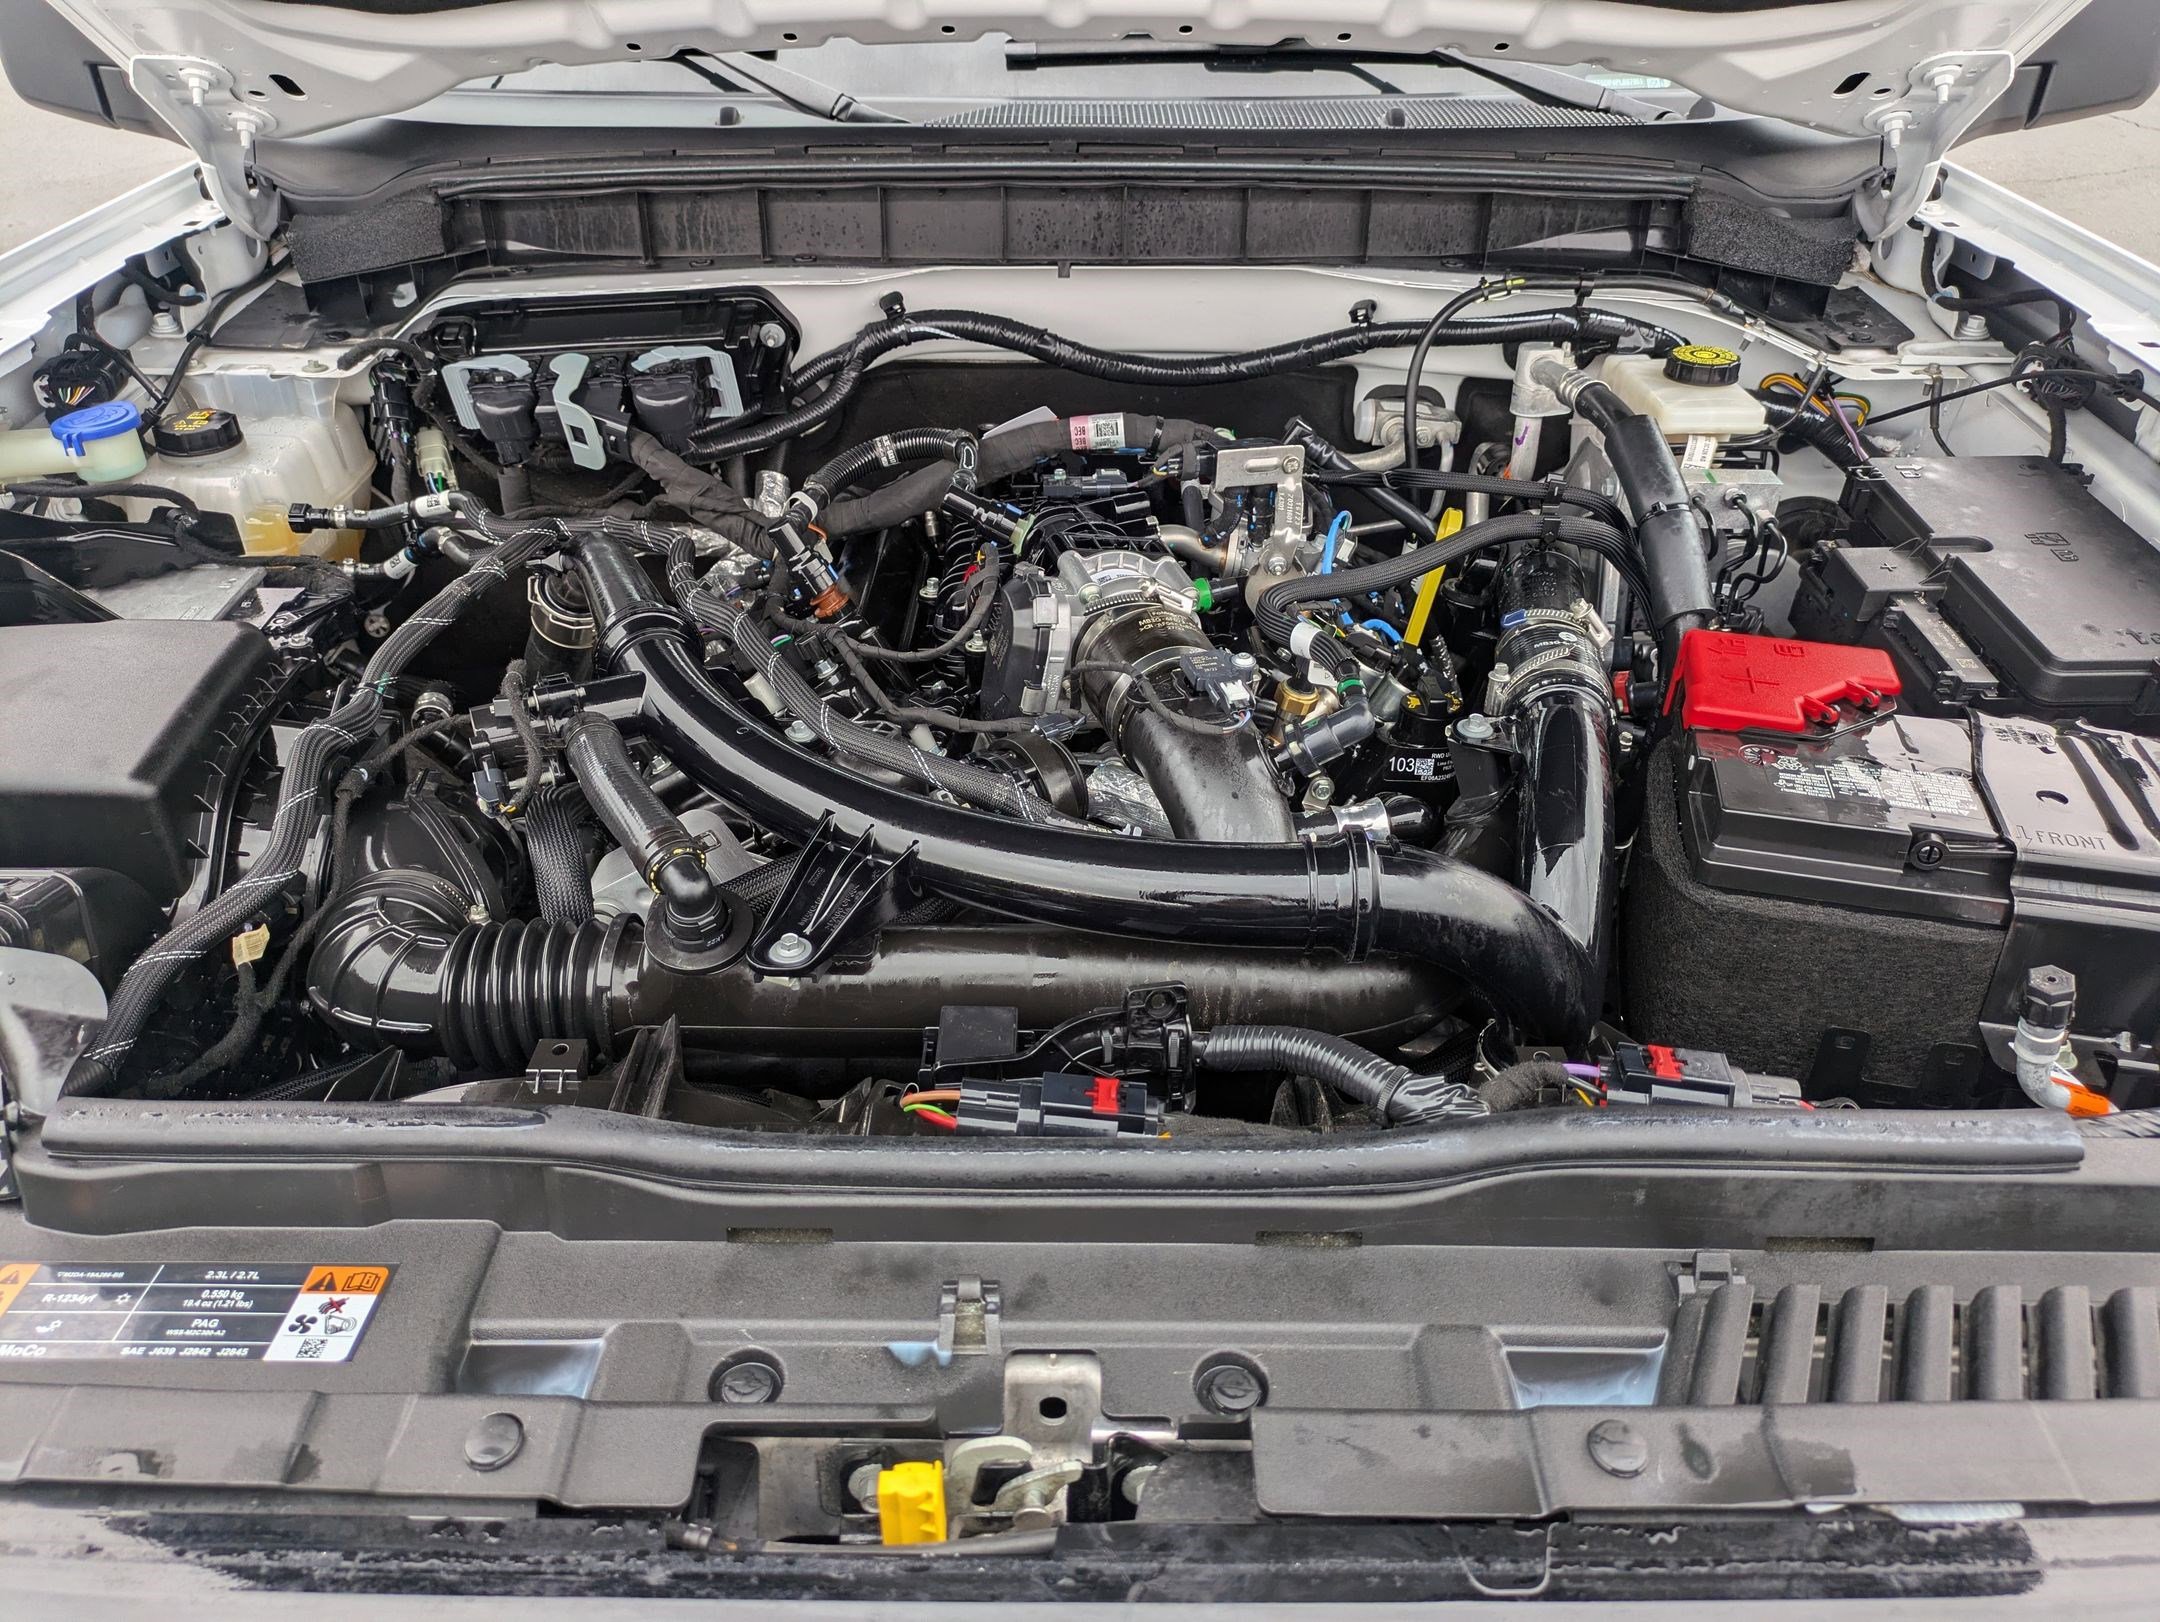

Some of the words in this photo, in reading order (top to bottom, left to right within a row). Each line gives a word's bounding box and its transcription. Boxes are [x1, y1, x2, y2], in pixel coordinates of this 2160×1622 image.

[1074, 426, 1086, 436] BEC
[1389, 756, 1415, 772] 103
[2035, 830, 2105, 850] FRONT
[204, 1270, 229, 1280] 2.3L
[236, 1271, 260, 1280] 2.7L
[41, 1293, 98, 1304] R-1234yf
[201, 1289, 230, 1299] 0.550
[230, 1290, 245, 1301] kg
[191, 1318, 219, 1328] PAG
[120, 1347, 146, 1356] SAE
[148, 1347, 176, 1356] J639
[216, 1348, 249, 1357] J2845
